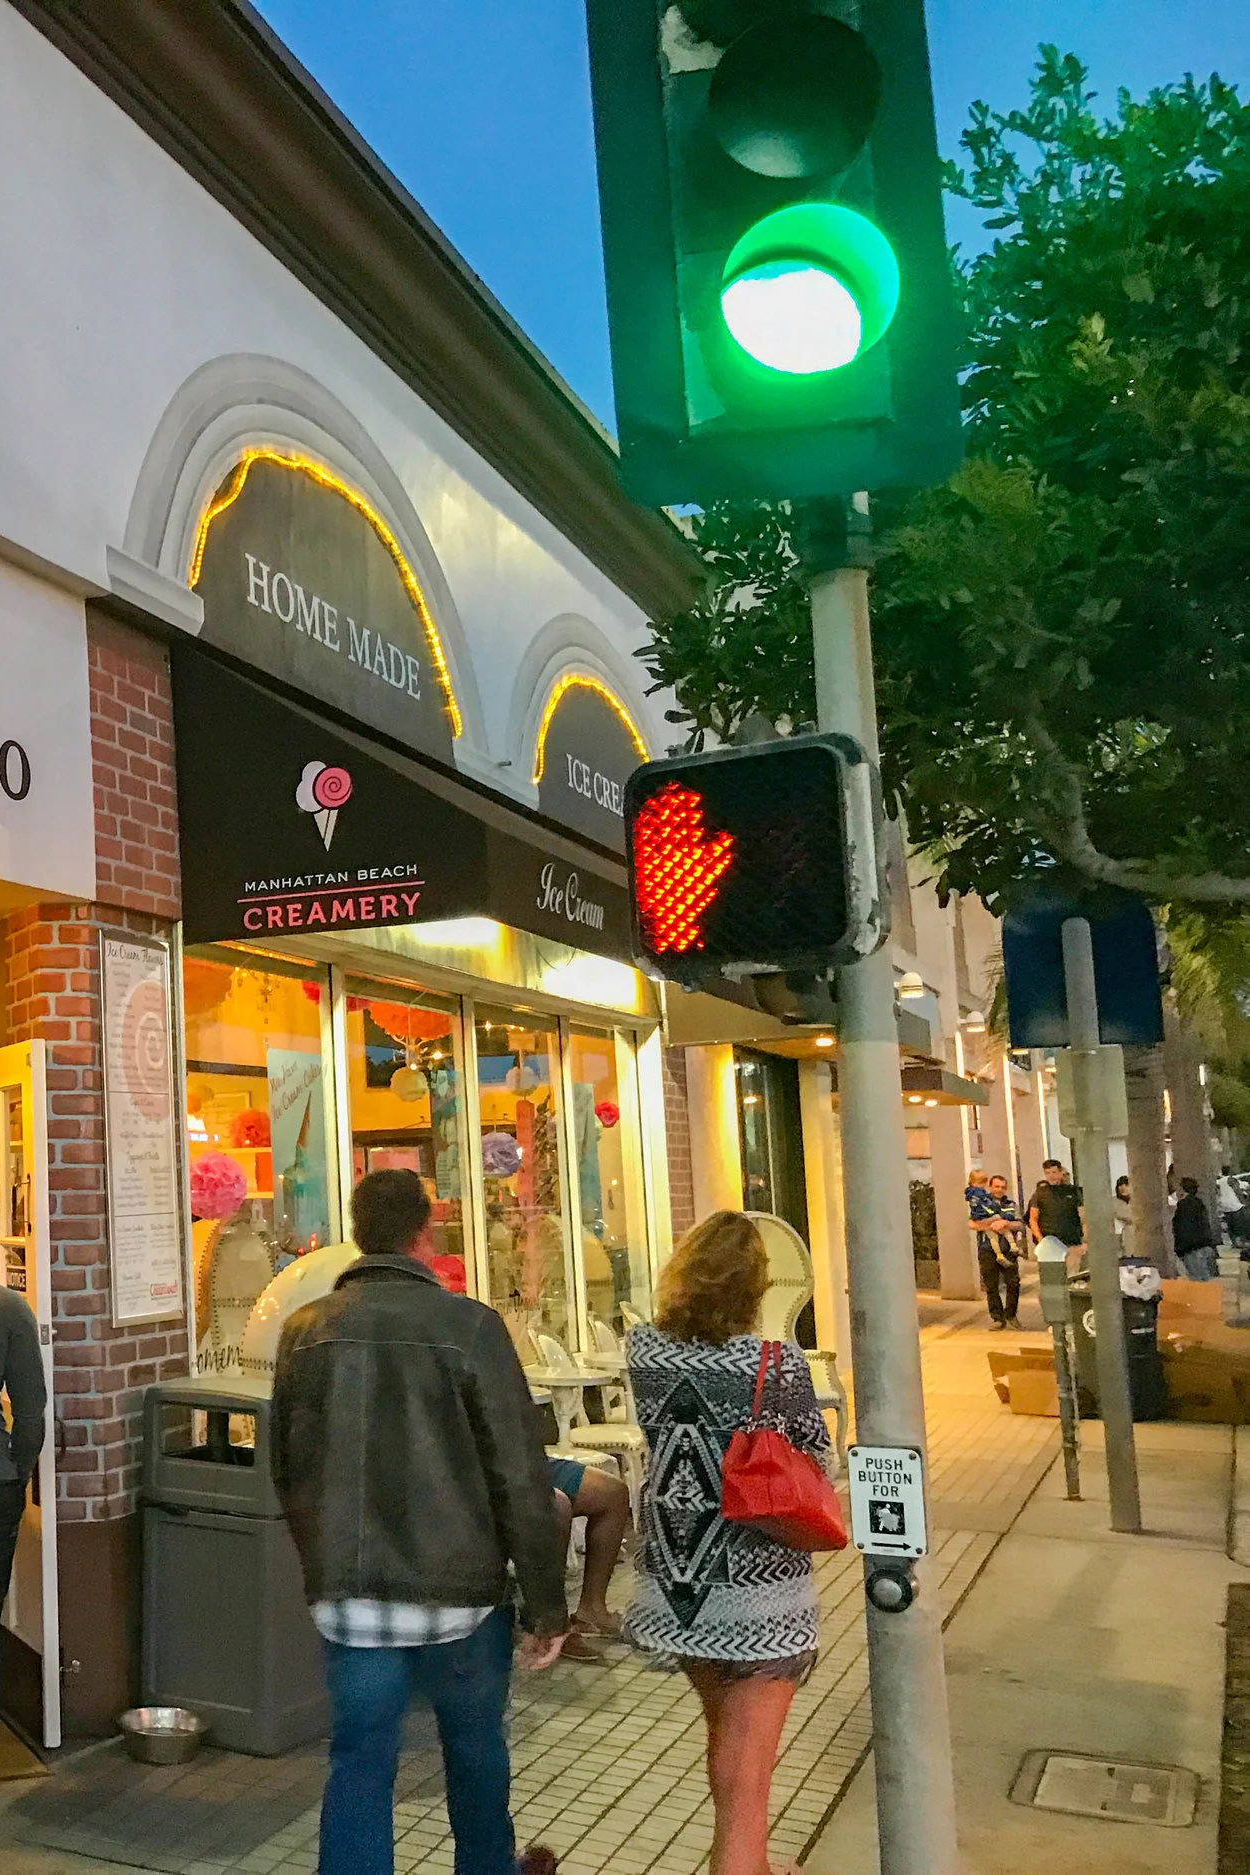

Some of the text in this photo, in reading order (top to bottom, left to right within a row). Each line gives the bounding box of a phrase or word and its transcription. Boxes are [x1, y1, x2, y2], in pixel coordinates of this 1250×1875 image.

[244, 553, 421, 701] HOME MADE
[566, 753, 591, 798] ICE
[244, 864, 418, 892] MANHATTAN BEACH
[243, 892, 421, 931] CREAMERY
[537, 862, 604, 930] Ice Cream
[858, 1470, 912, 1485] BUTTON
[866, 1458, 903, 1470] PUSH
[872, 1485, 899, 1497] FOR
